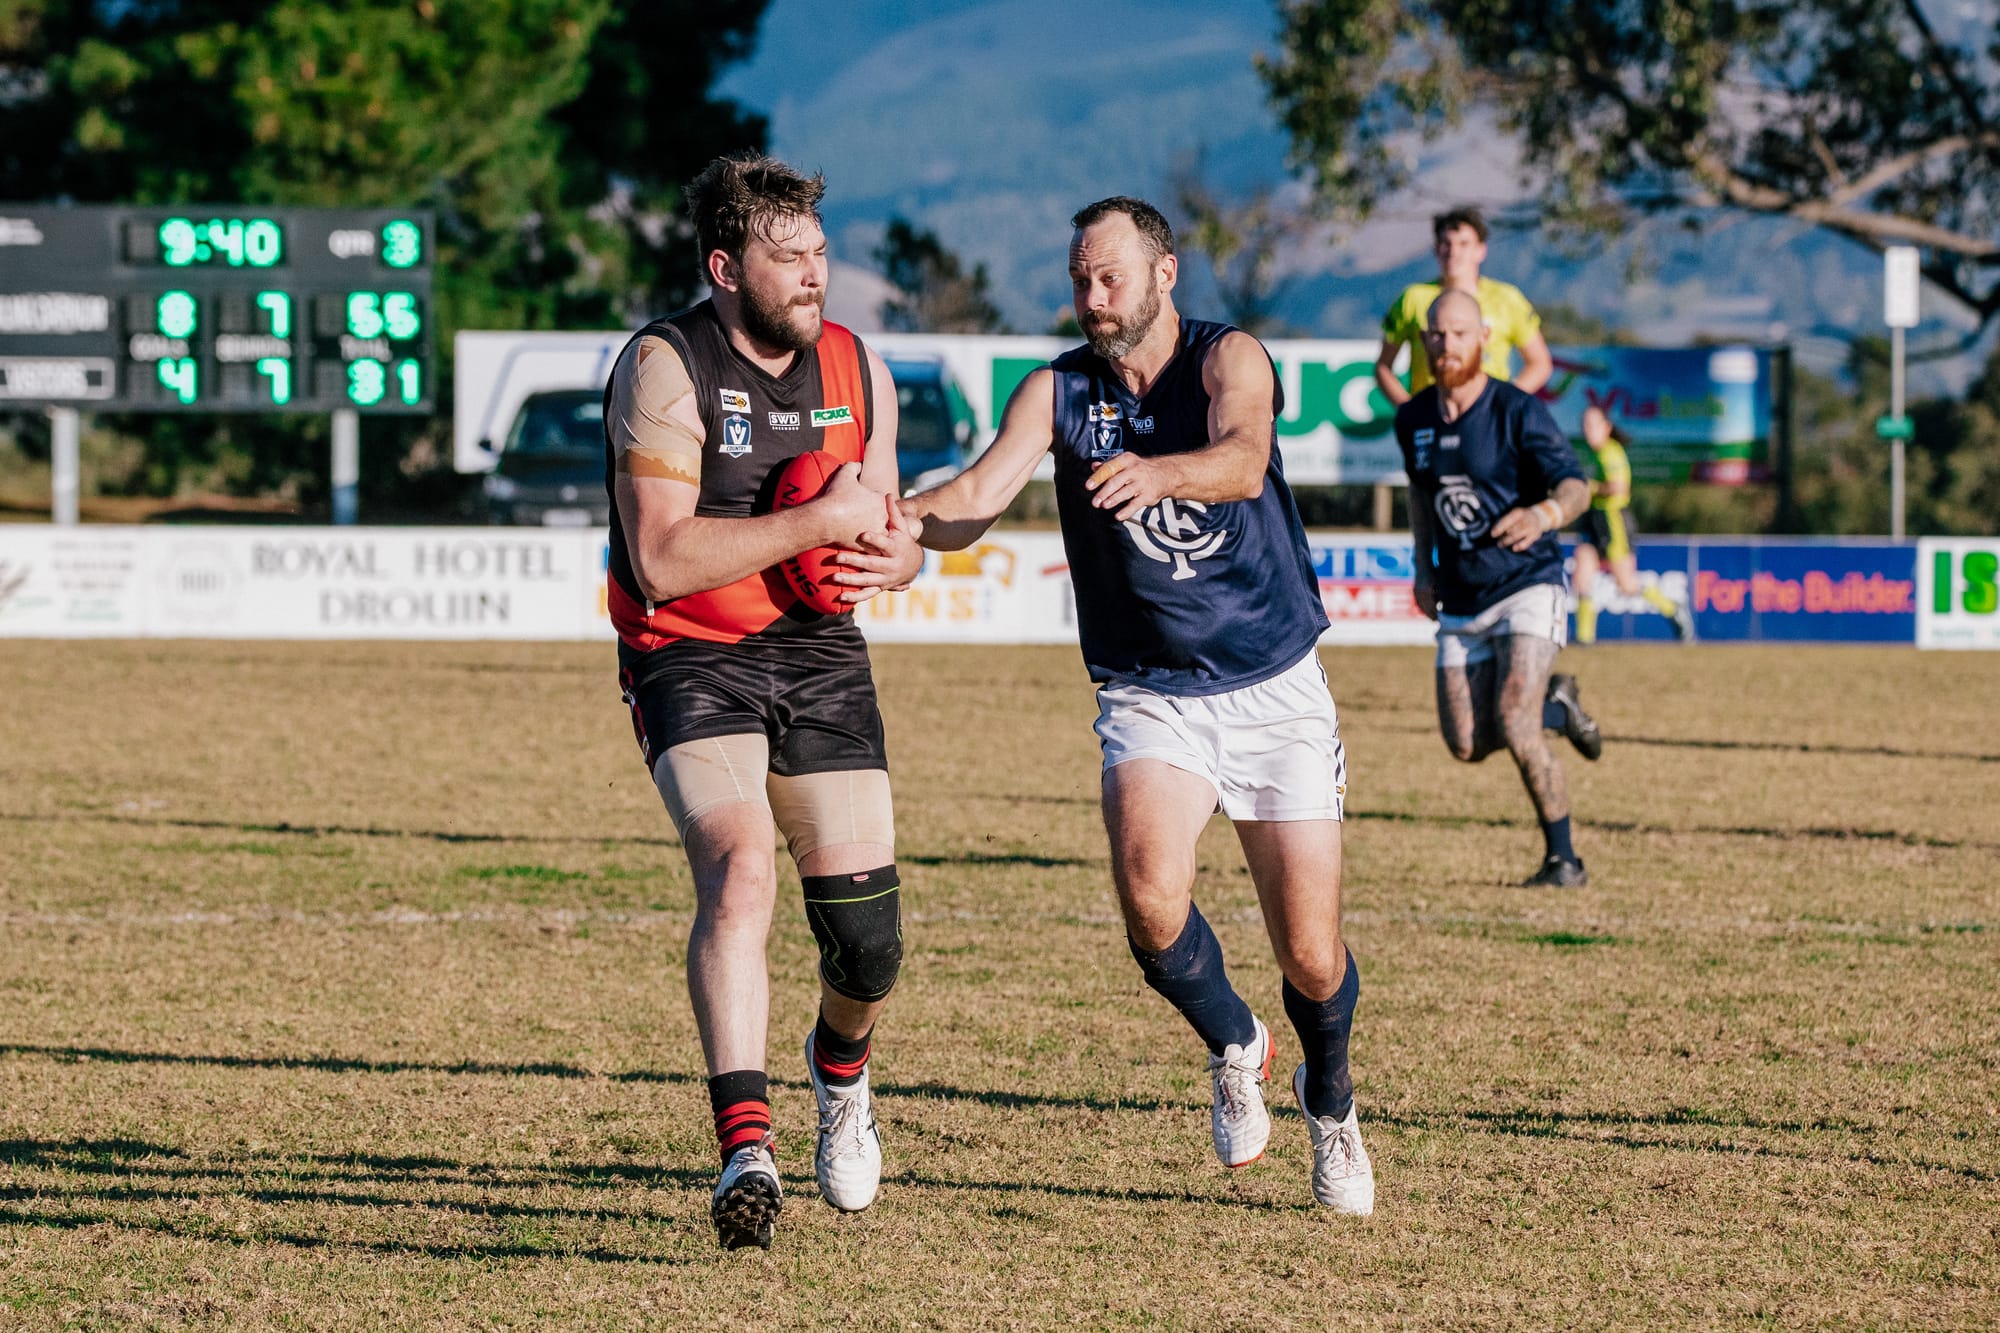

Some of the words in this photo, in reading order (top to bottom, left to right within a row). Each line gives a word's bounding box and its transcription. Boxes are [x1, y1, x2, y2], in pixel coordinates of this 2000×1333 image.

[159, 218, 281, 267] 9:40
[383, 219, 420, 268] 3
[158, 290, 197, 339] 8
[257, 291, 290, 339] 7
[347, 291, 420, 340] 55
[158, 356, 197, 404] 4
[257, 357, 290, 405] 7
[347, 357, 420, 405] 31
[771, 414, 798, 425] SWD
[252, 540, 391, 578] ROYAL
[412, 540, 566, 579] HOTEL
[319, 590, 511, 623] DROUIN
[1694, 570, 1749, 613] For
[1752, 571, 1801, 613] the
